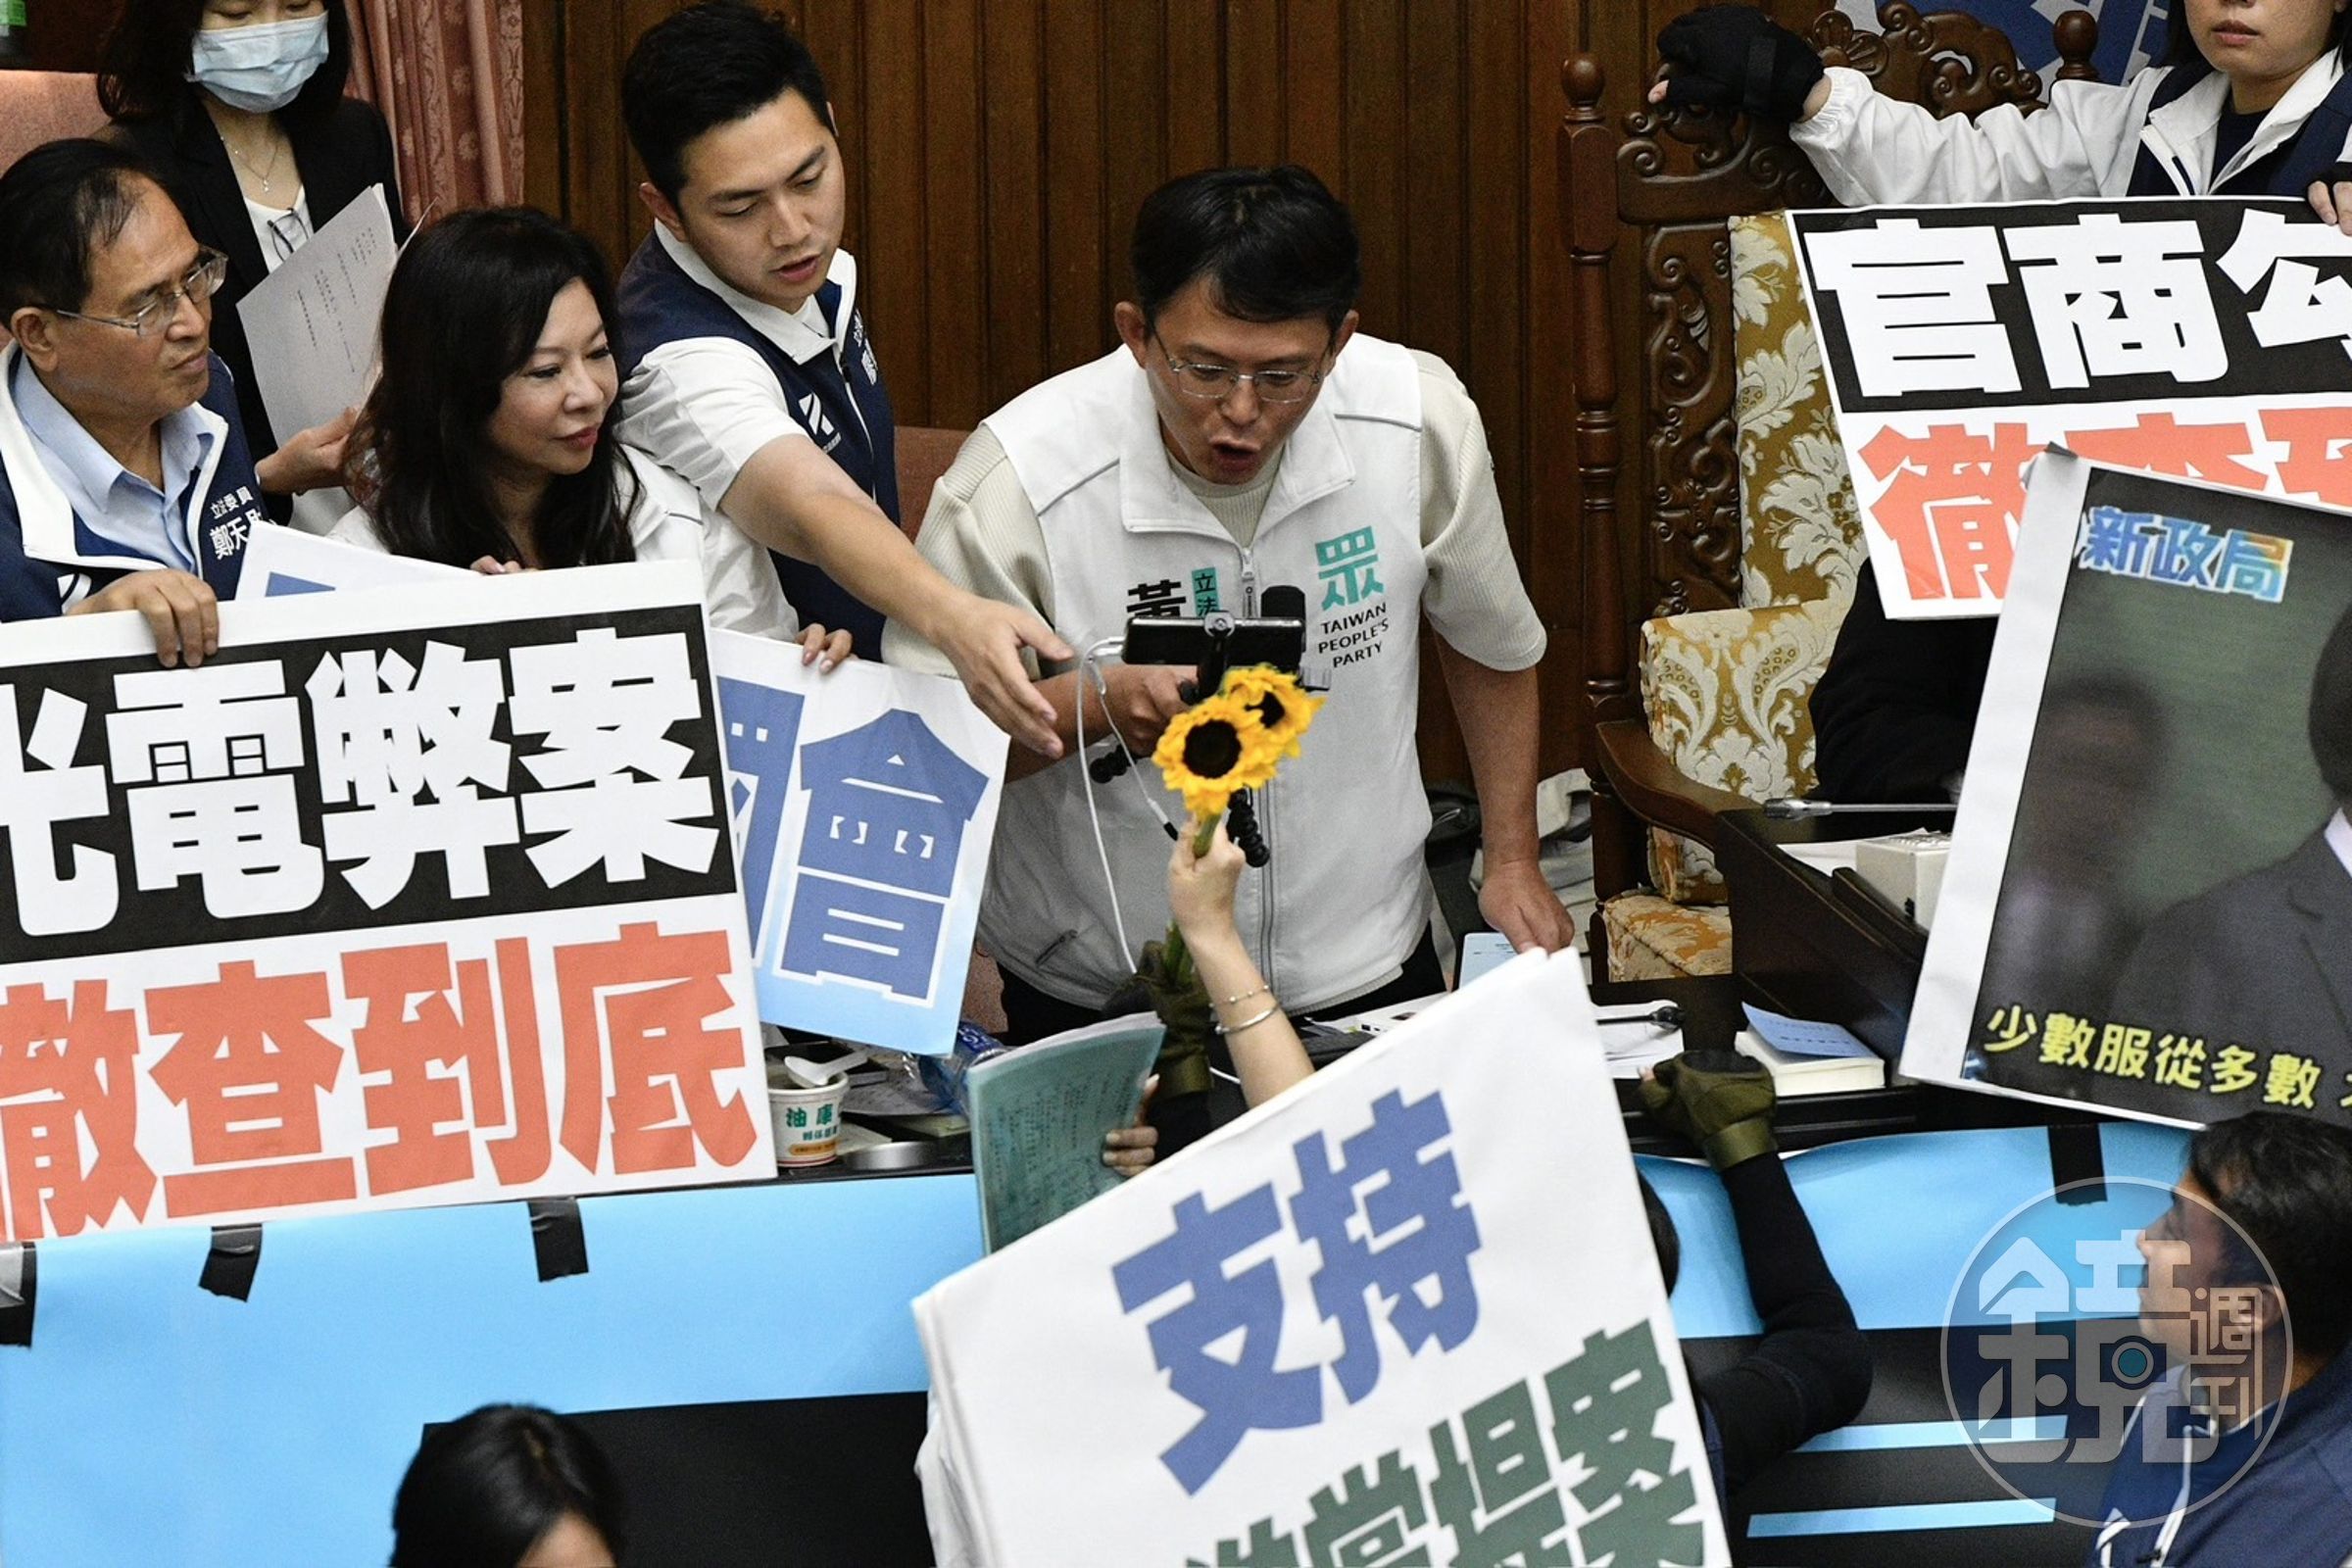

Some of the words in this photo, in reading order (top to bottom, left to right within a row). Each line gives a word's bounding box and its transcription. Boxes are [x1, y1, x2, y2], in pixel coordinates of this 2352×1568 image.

[1315, 525, 1384, 612] 眾
[2074, 504, 2294, 604] 新政局
[1317, 618, 1390, 654] PEOPLE'S
[1320, 602, 1387, 634] TAIWAN
[1332, 641, 1383, 668] PARTY
[1984, 1004, 2322, 1109] 少數服從多數
[1110, 1088, 1482, 1496] 支持
